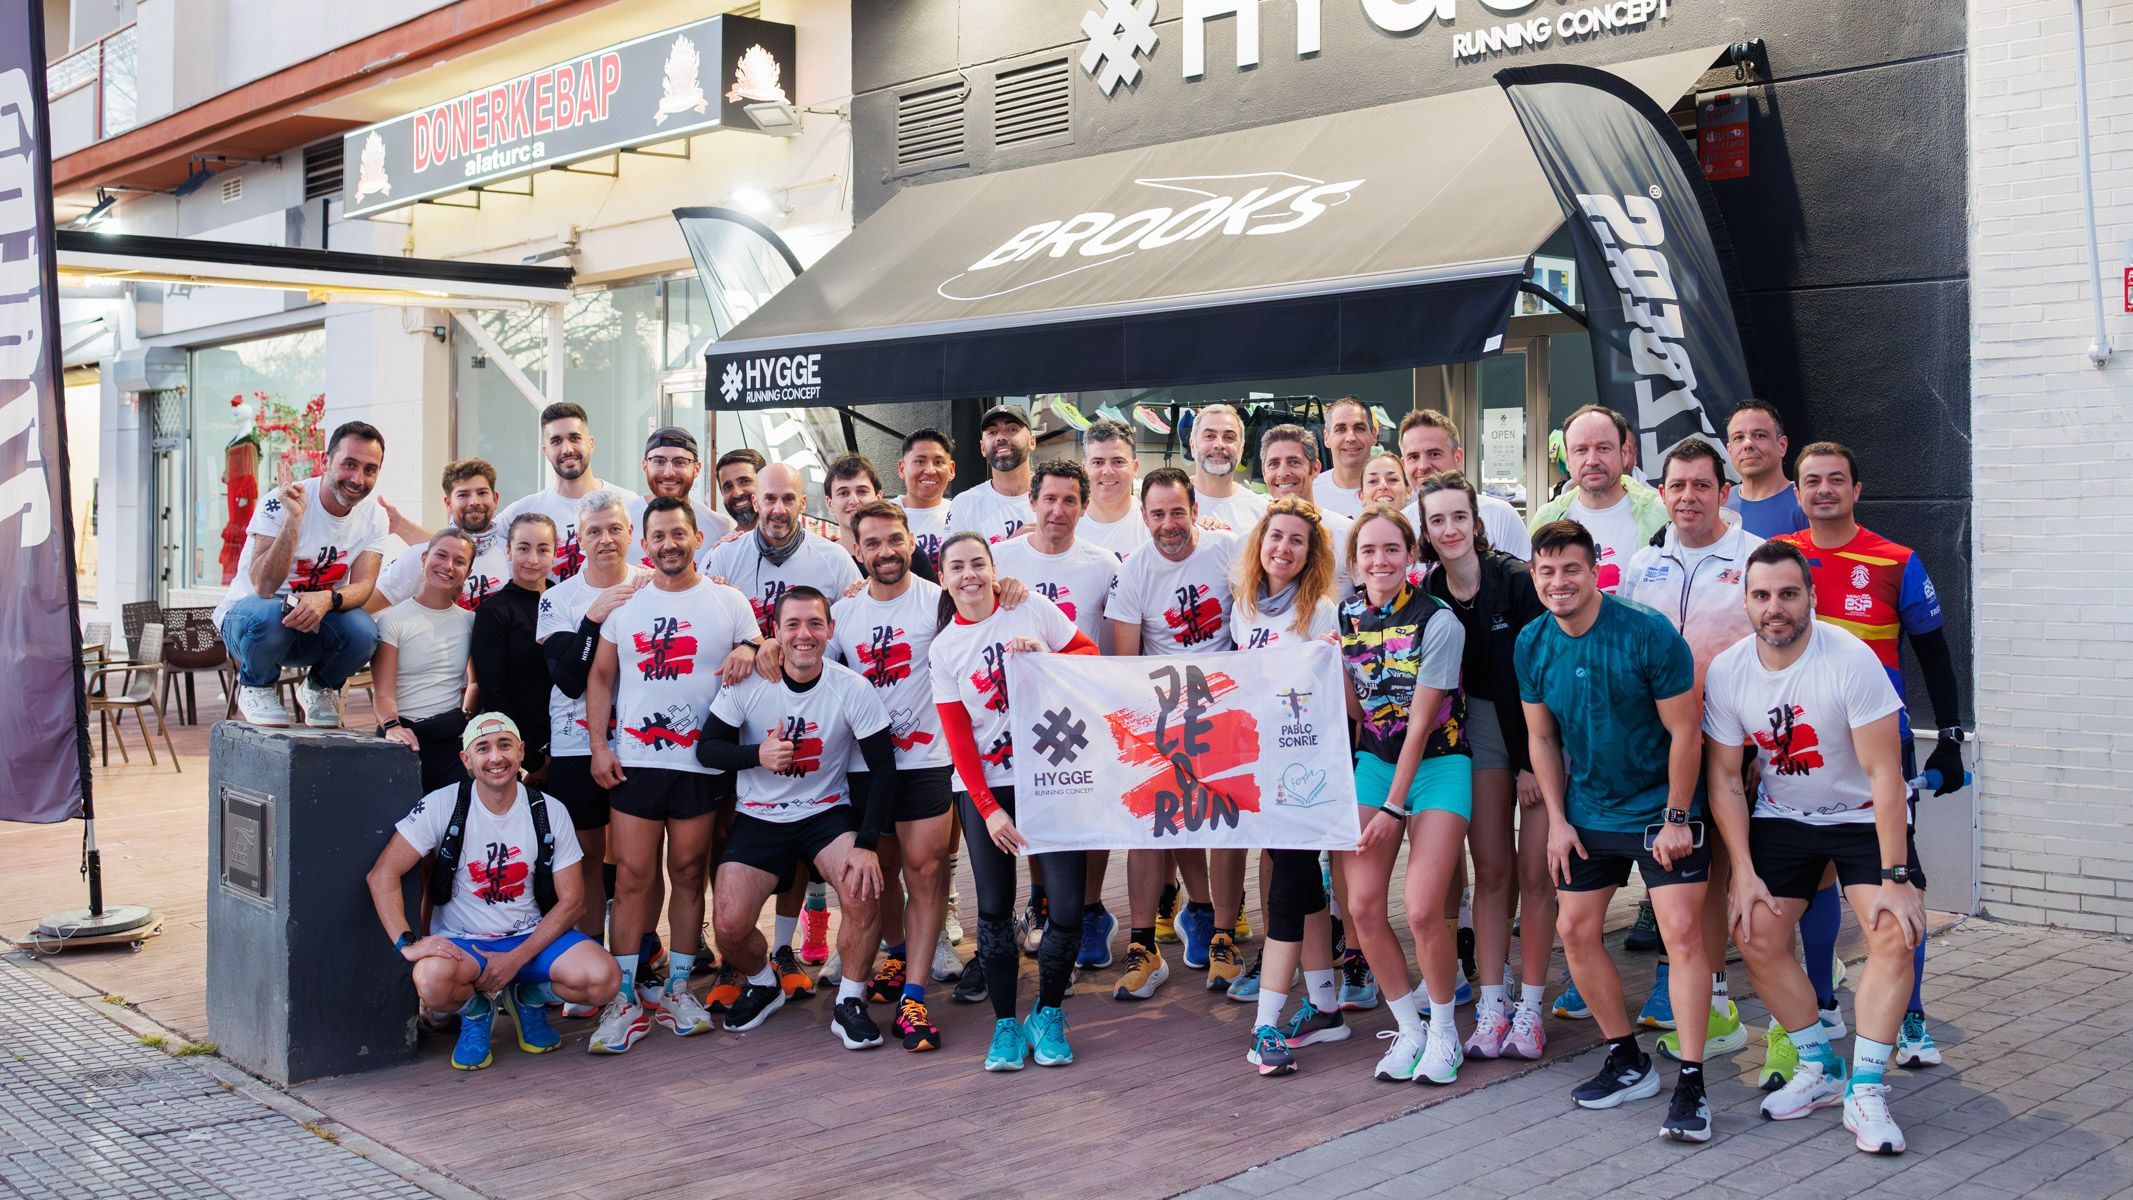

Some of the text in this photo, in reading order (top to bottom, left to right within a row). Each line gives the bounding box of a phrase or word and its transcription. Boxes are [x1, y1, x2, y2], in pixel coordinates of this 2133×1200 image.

[1453, 16, 1552, 58] RUNNING
[1556, 0, 1669, 37] CONCEPT
[464, 141, 545, 176] alaturca
[968, 179, 1366, 271] BROOKS
[745, 353, 822, 390] HYGGE
[745, 386, 822, 403] RUNNING CONCEPT
[1491, 430, 1516, 440] OPEN
[654, 617, 678, 633] JA
[581, 636, 593, 661] KIPRUN
[643, 664, 679, 682] RUN
[1149, 665, 1215, 712] JA
[1155, 706, 1214, 756] LE
[1281, 723, 1313, 735] PABLO
[1034, 770, 1094, 787] HYGGE
[1171, 752, 1199, 791] O
[1065, 787, 1094, 796] CONCEPT
[1153, 783, 1240, 838] RUN
